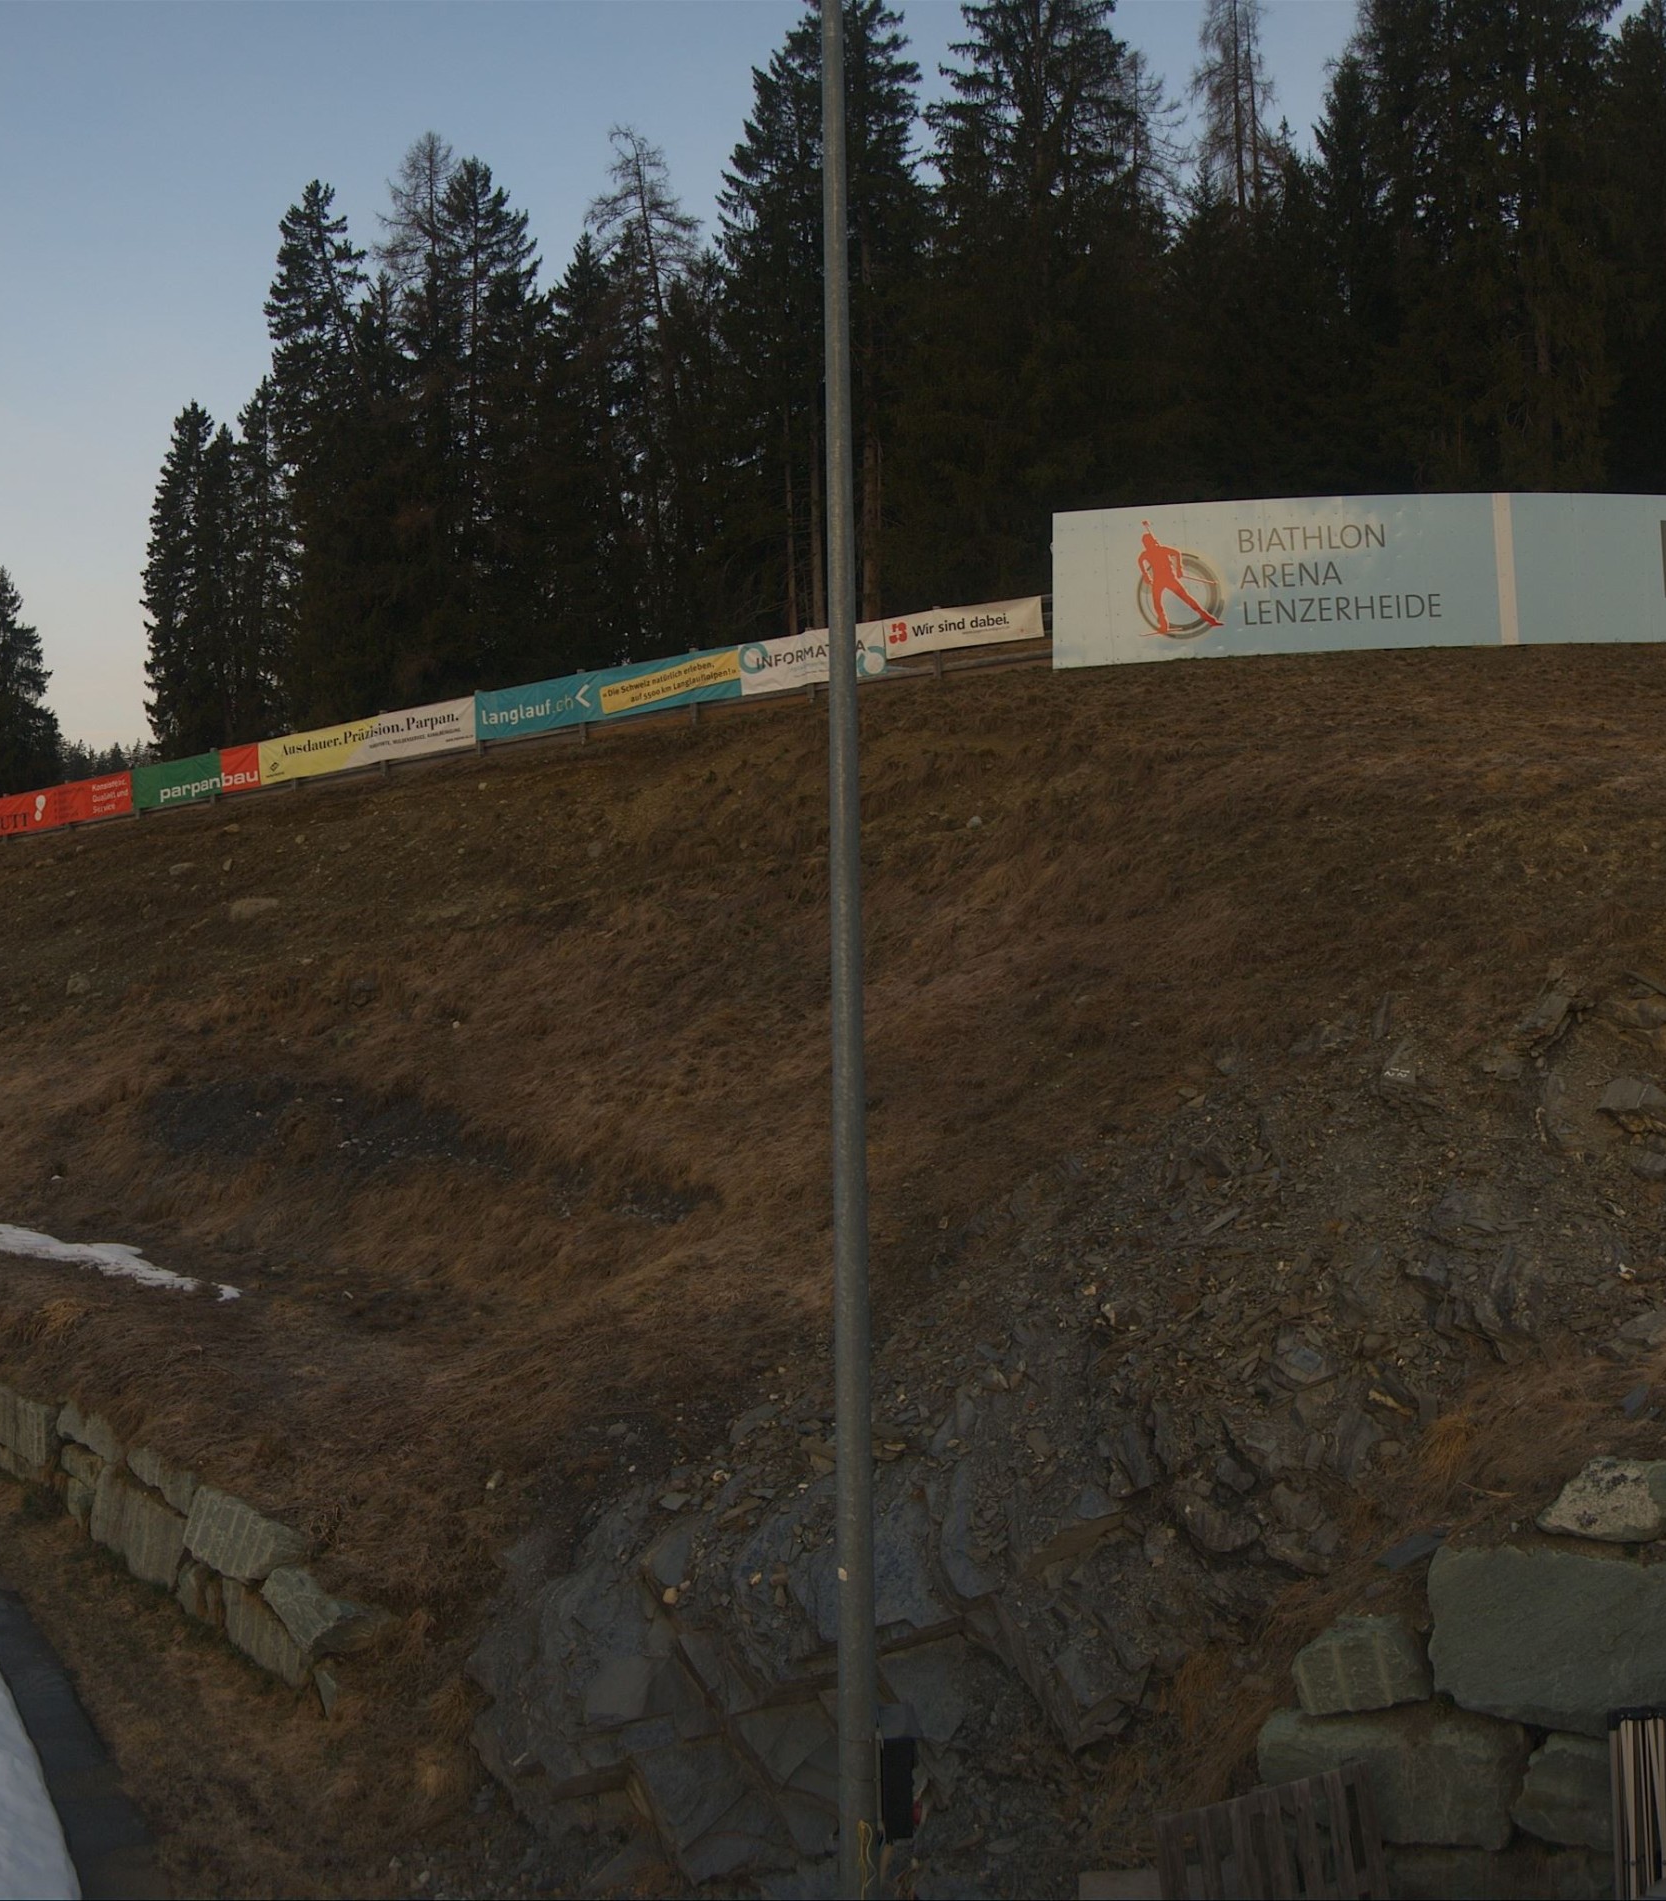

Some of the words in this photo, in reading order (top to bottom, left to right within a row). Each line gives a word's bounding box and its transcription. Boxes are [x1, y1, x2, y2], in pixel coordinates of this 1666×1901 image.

[1237, 523, 1386, 553] BIATHLON
[1240, 561, 1343, 589] ARENA
[1243, 593, 1442, 626] LENZERHEIDE
[912, 623, 935, 637] Wir
[938, 618, 965, 633] sind
[970, 613, 1010, 629] dabei.
[620, 680, 651, 696] Schweiz
[651, 669, 683, 688] natürlich
[683, 662, 715, 676] erleben,
[630, 693, 643, 703] auf
[643, 689, 661, 701] 5500
[661, 684, 673, 694] km
[482, 696, 575, 726] langlauf.ch
[344, 722, 405, 745] Präzision.
[406, 714, 460, 732] Parpan.
[159, 770, 259, 803] parpanbau
